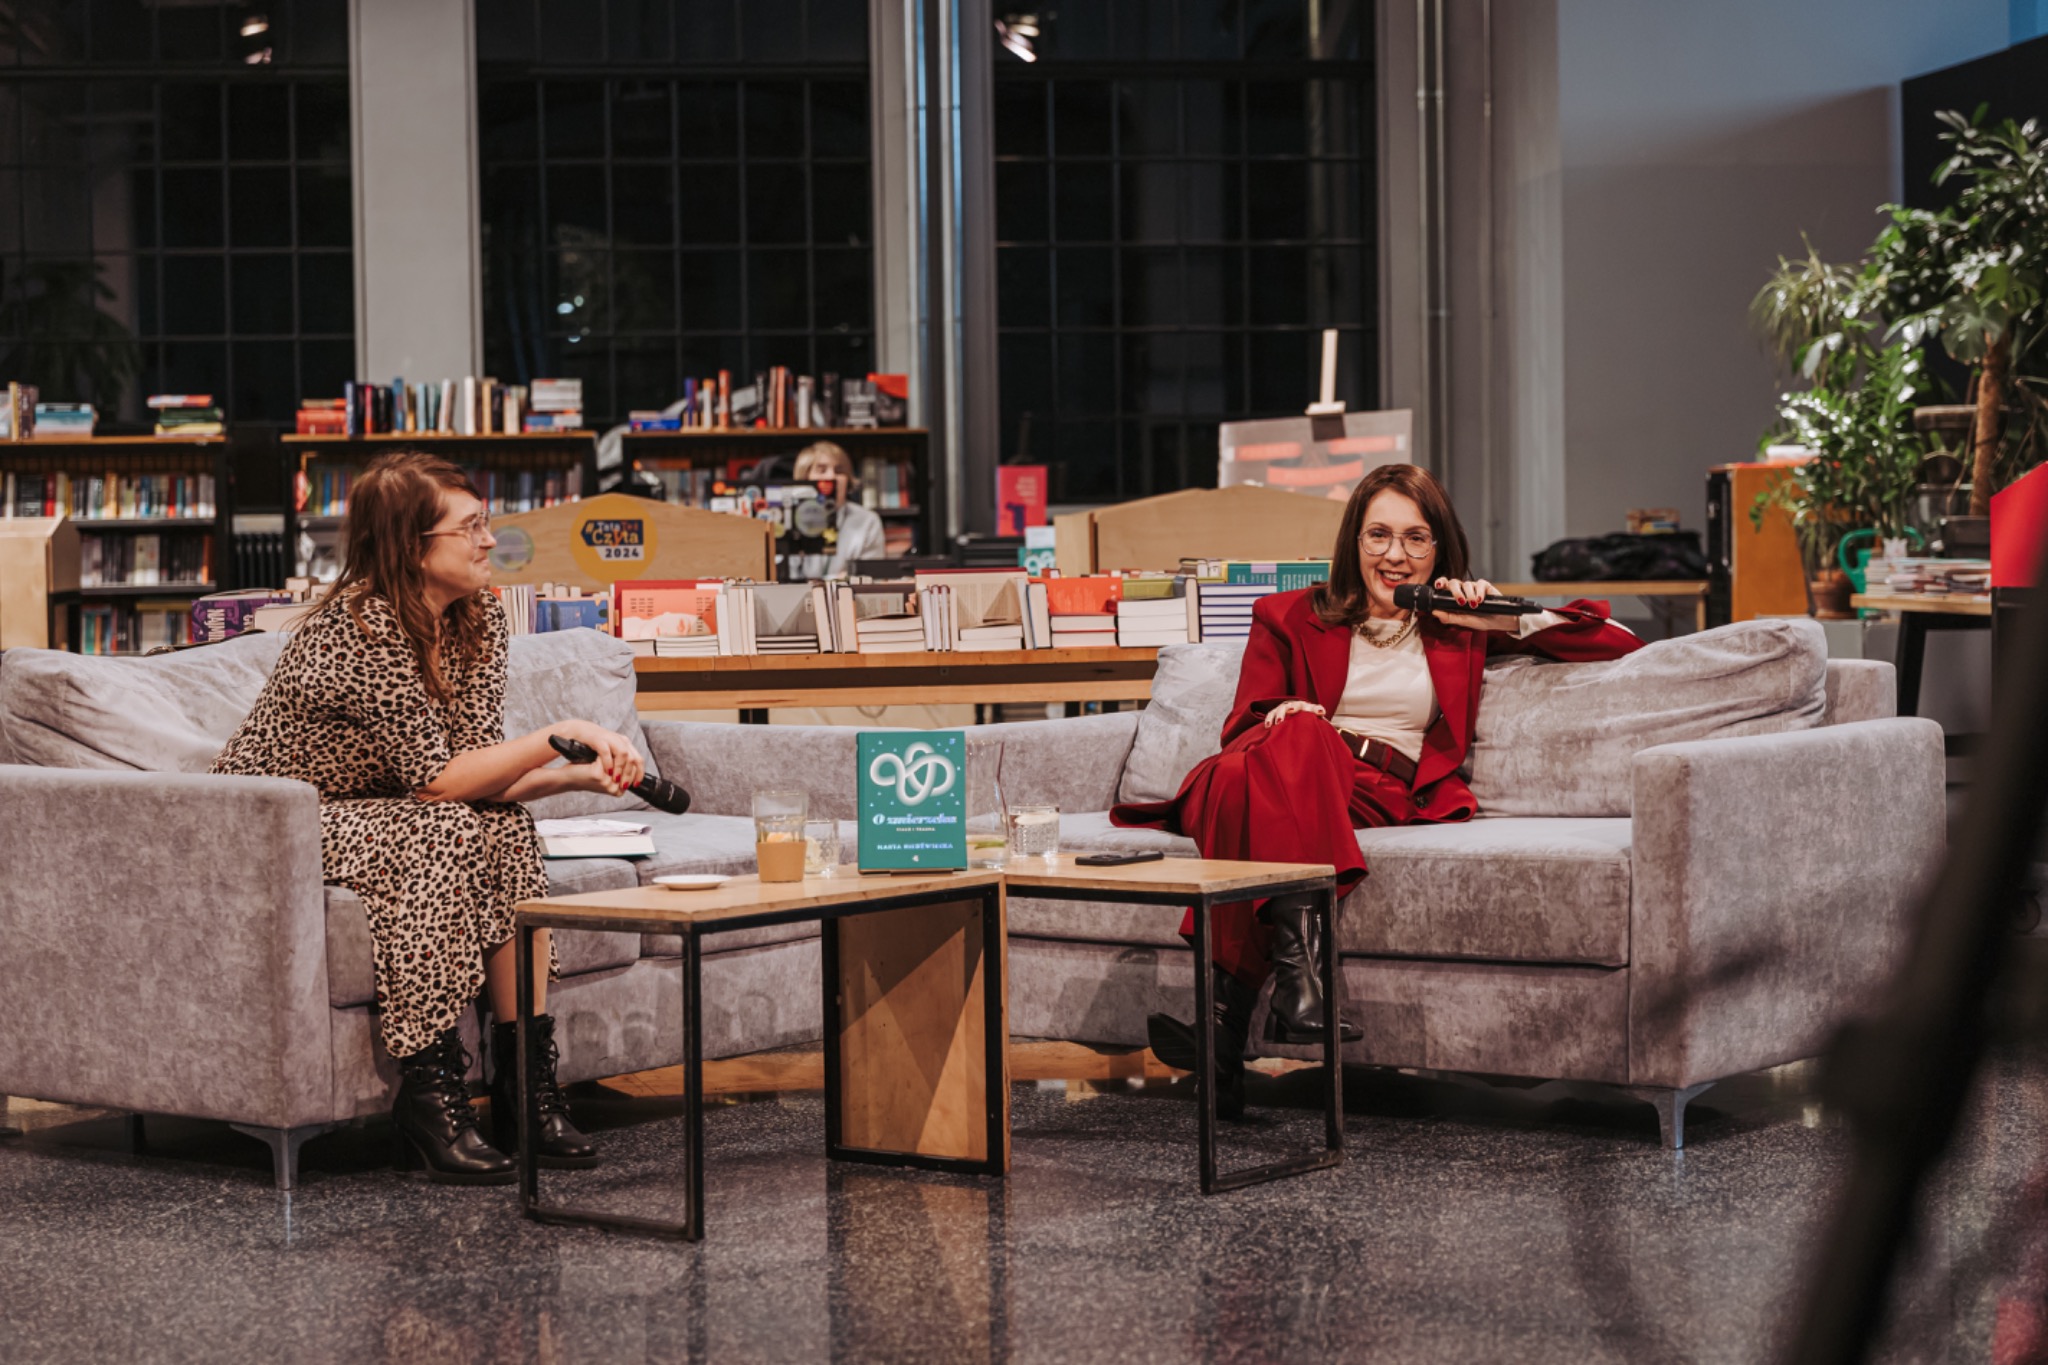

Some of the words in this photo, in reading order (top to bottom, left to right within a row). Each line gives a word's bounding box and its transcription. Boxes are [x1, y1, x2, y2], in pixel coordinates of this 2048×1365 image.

[592, 528, 639, 546] Czyta
[605, 548, 639, 558] 2024
[872, 813, 886, 825] O
